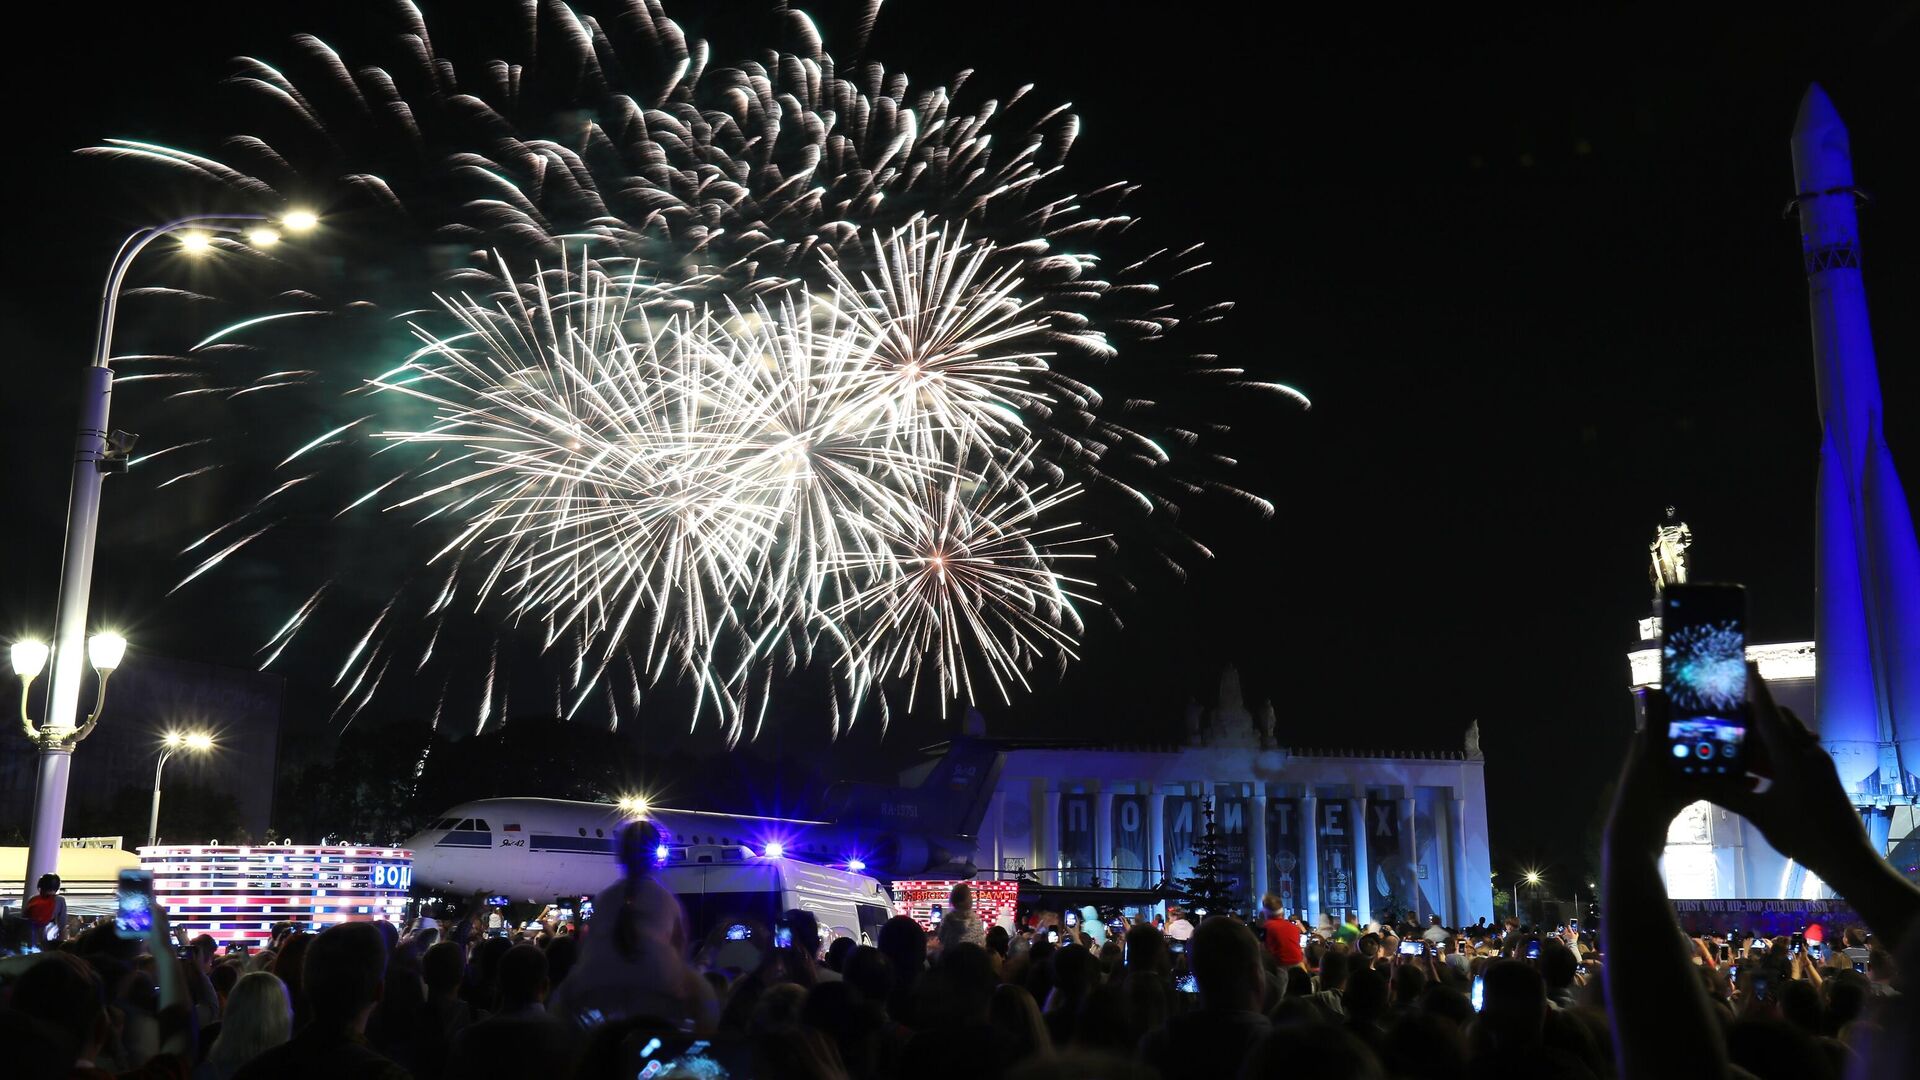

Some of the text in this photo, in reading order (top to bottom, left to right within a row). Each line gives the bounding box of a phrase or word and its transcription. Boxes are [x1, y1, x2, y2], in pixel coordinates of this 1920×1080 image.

[1068, 800, 1393, 837] ПОЛИТЕХ
[1677, 900, 1702, 912] FIRST
[1702, 900, 1725, 912] WAVE
[1727, 900, 1763, 912] HIP-HOP
[1765, 900, 1804, 913] CULTURE
